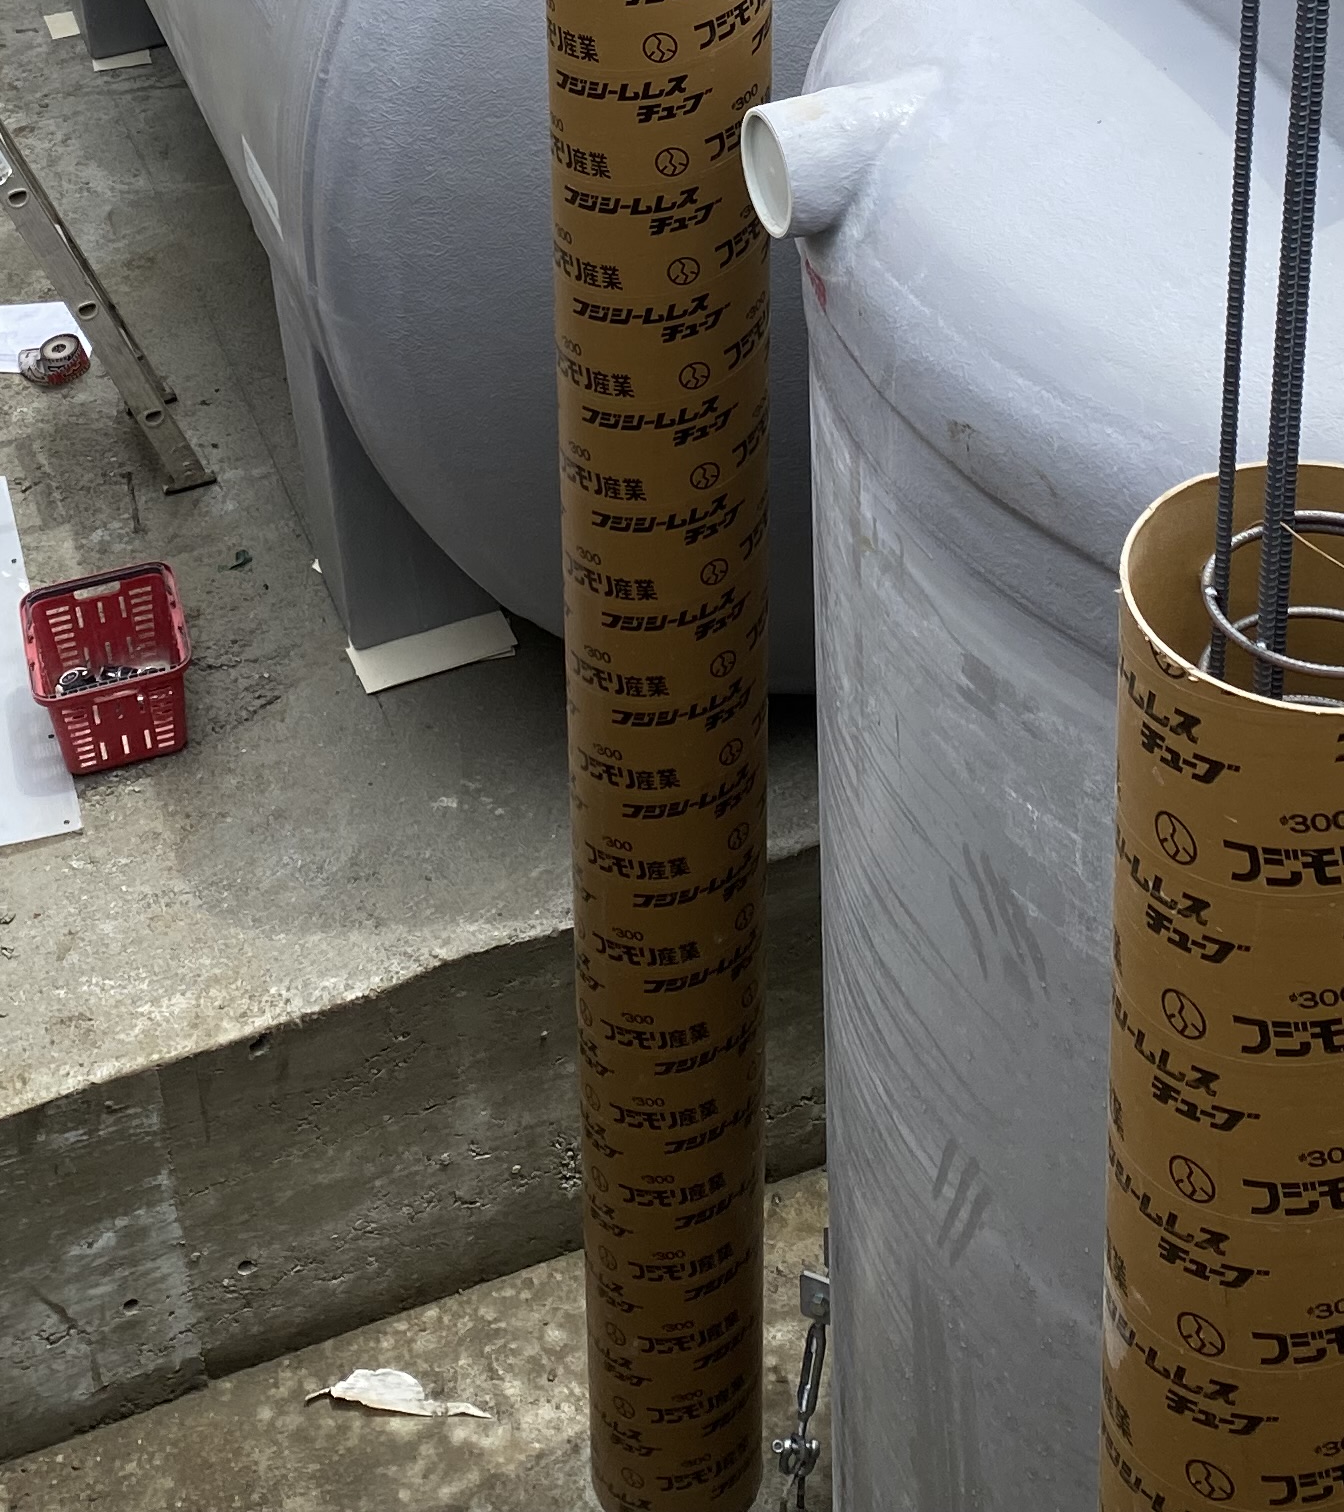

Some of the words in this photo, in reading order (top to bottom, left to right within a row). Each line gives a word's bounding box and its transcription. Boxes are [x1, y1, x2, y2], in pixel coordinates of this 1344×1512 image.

[556, 70, 688, 102] フジシームレス
[636, 88, 713, 123] チューブ
[564, 186, 699, 215] フジシームレス
[649, 197, 722, 236] チューブ
[572, 293, 709, 325] フジシームレス
[582, 395, 719, 431] フジシームレス
[591, 493, 728, 533] フジシームレス
[601, 586, 736, 632] フジシームレス
[1140, 726, 1241, 784] チューブ
[585, 841, 692, 880] フジモリ産業
[592, 932, 701, 967] フジモリ産業
[1145, 903, 1251, 965] チューブ
[600, 1018, 711, 1049] フジモリ産業
[1151, 1074, 1261, 1133] チューブ
[1158, 1236, 1270, 1289] チューブ
[1165, 1388, 1280, 1436] チューブ
